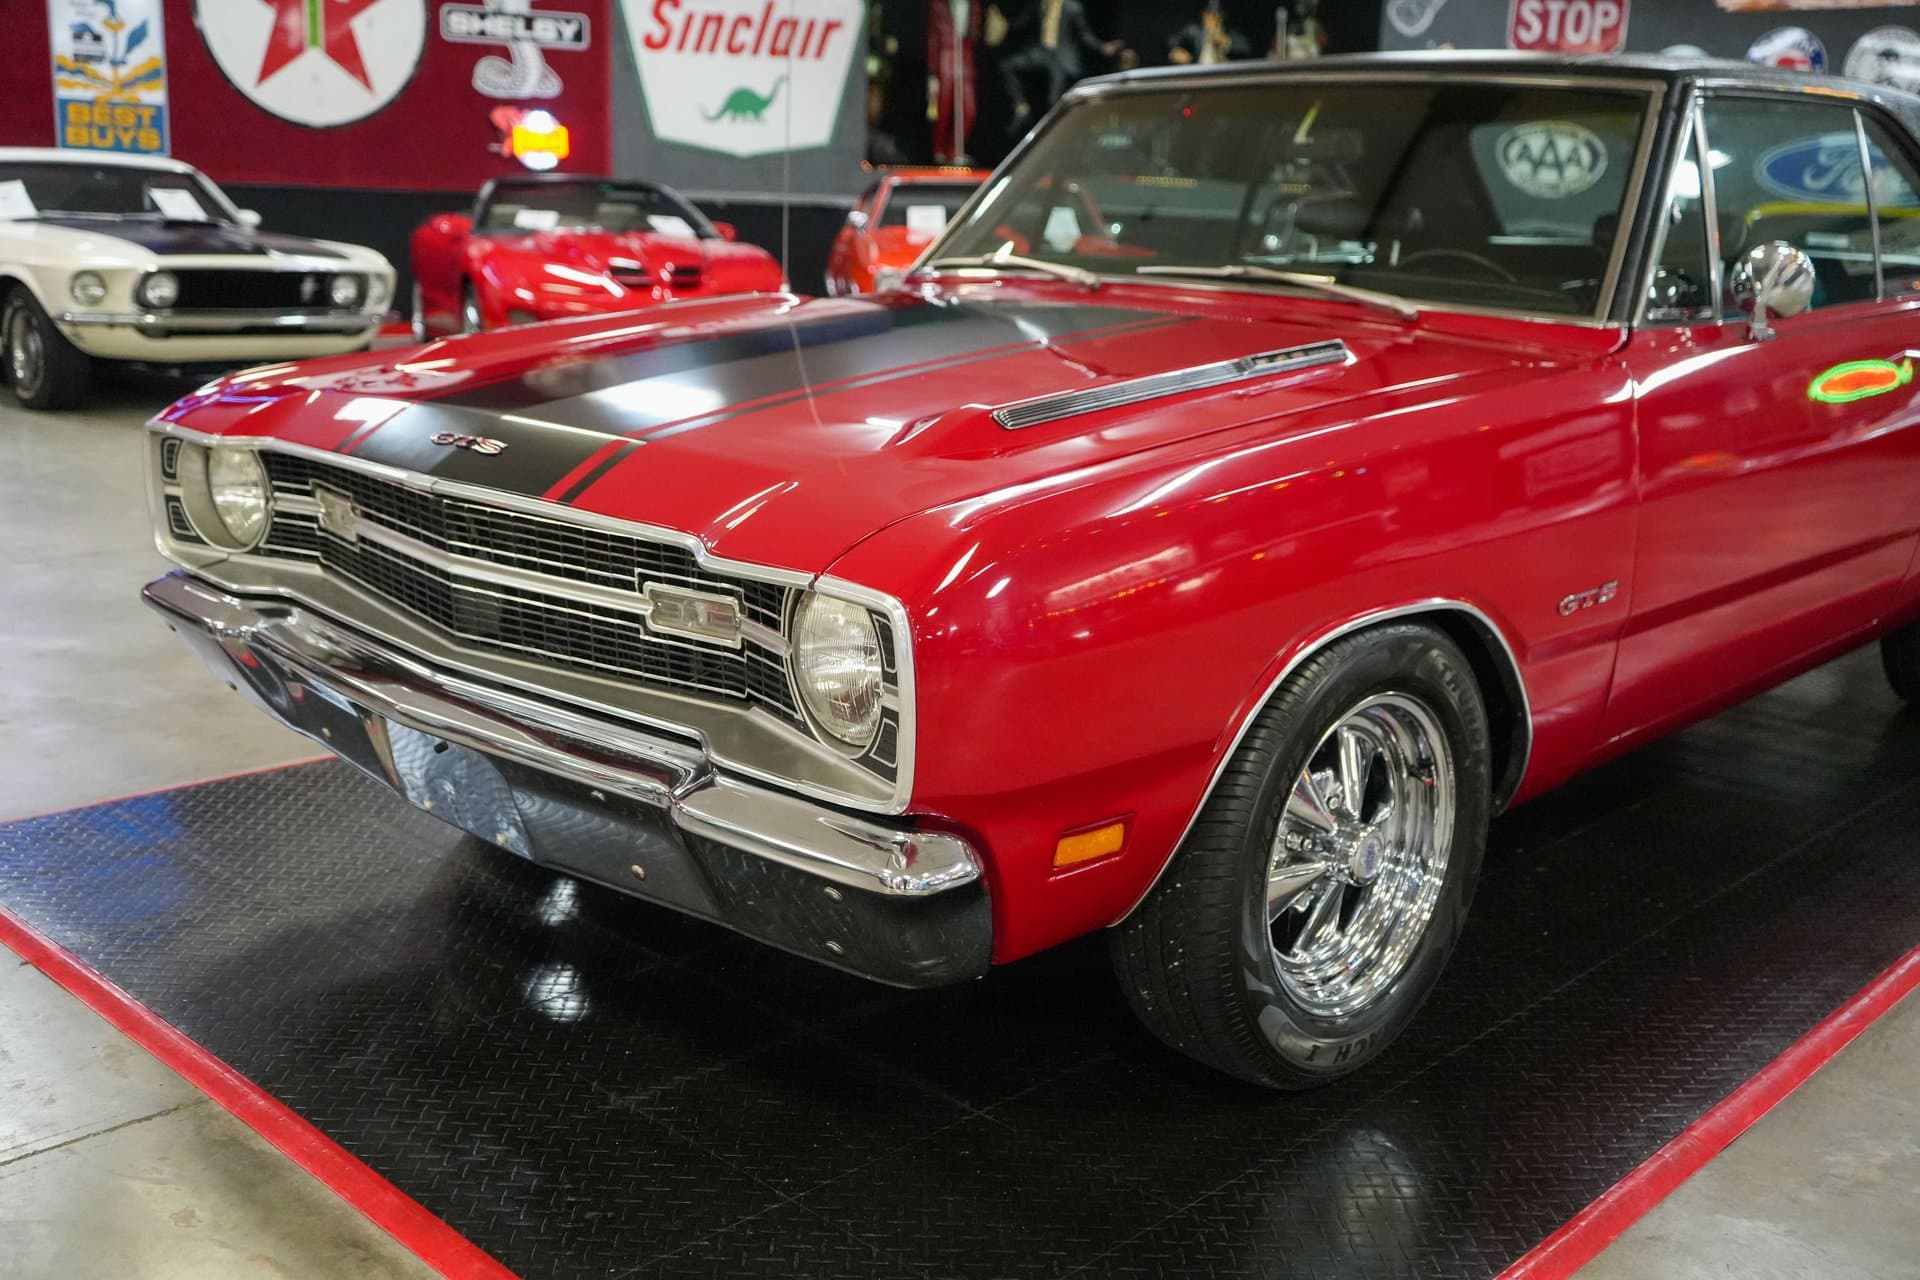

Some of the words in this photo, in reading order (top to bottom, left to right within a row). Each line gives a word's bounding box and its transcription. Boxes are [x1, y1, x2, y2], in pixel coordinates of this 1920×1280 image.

[447, 11, 581, 42] SHELBY
[643, 0, 843, 60] Sinclair
[1516, 0, 1620, 46] STOP
[66, 102, 156, 128] BEST
[66, 127, 160, 151] BUYS
[1516, 131, 1582, 180] AAA
[1802, 143, 1912, 196] Fo
[429, 431, 509, 455] GTS
[1559, 580, 1618, 616] GTS
